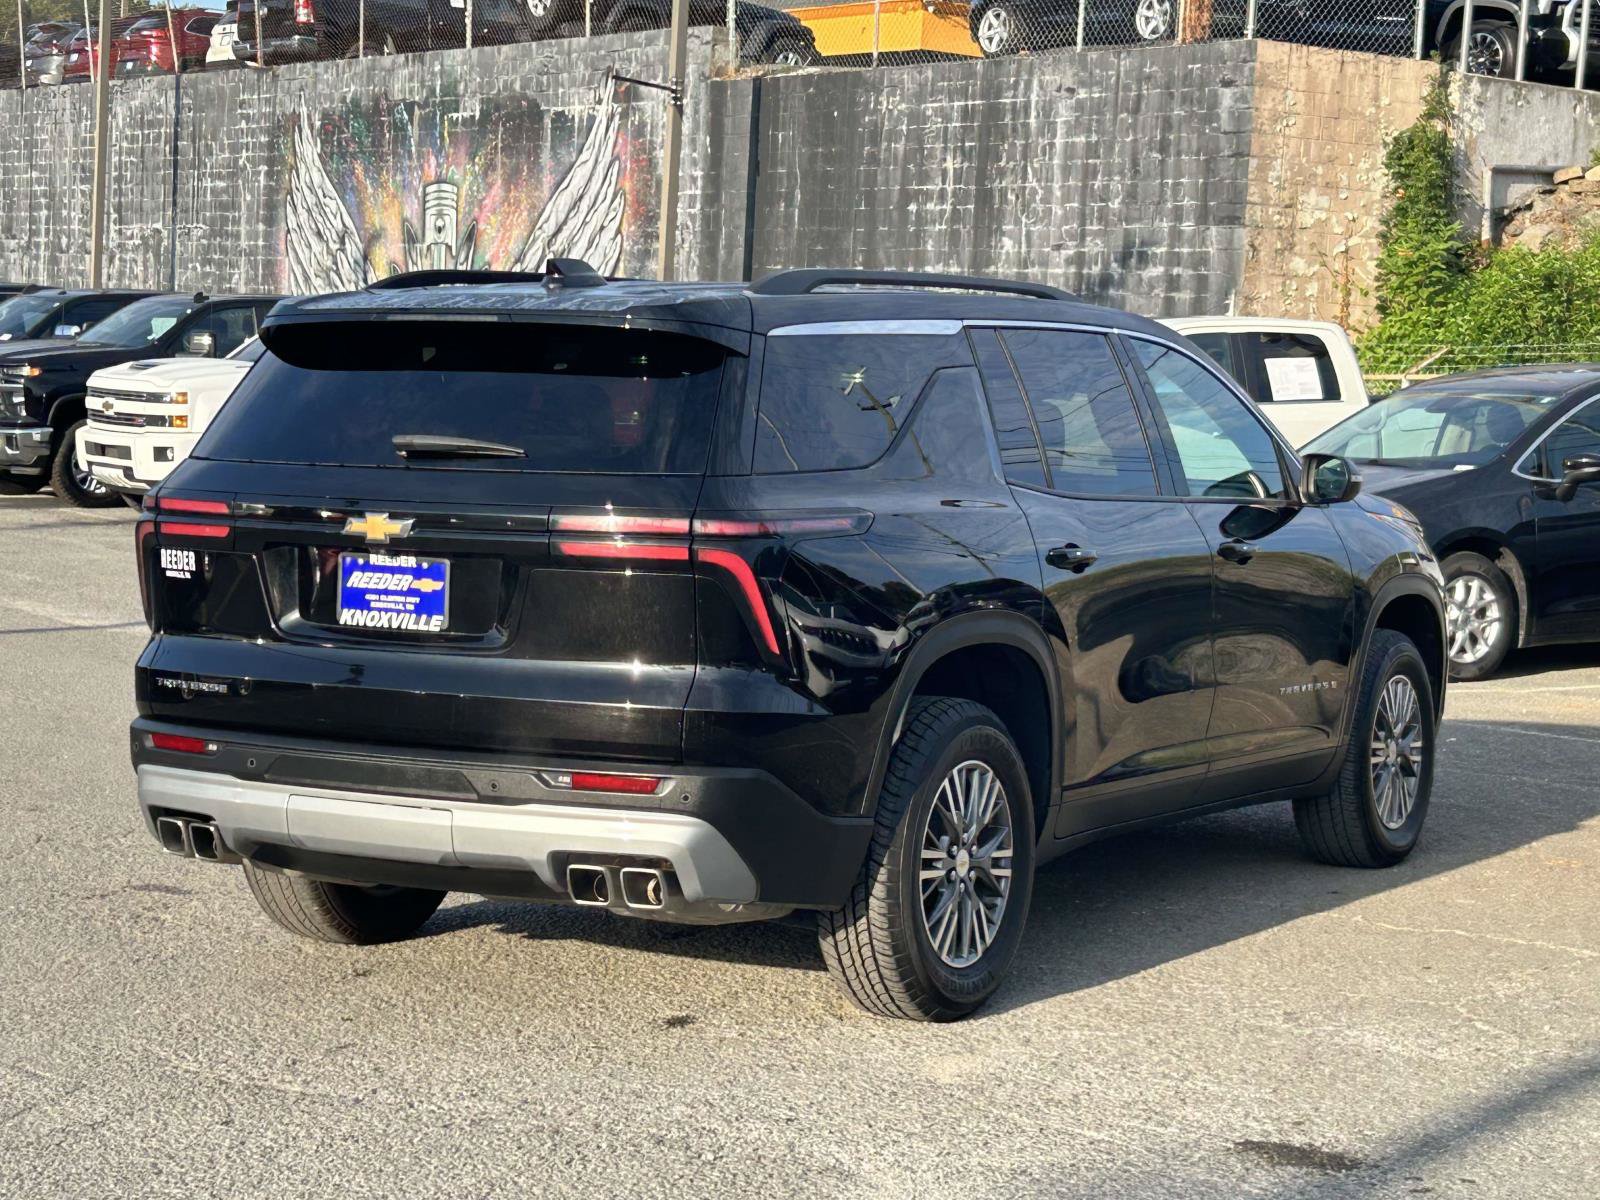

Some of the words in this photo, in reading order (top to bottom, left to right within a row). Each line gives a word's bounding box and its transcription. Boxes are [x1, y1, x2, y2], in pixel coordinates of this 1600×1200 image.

[160, 548, 196, 571] REEDER
[369, 553, 417, 568] REEDER
[346, 571, 414, 591] REEDER
[339, 608, 444, 632] KNOXVILLE
